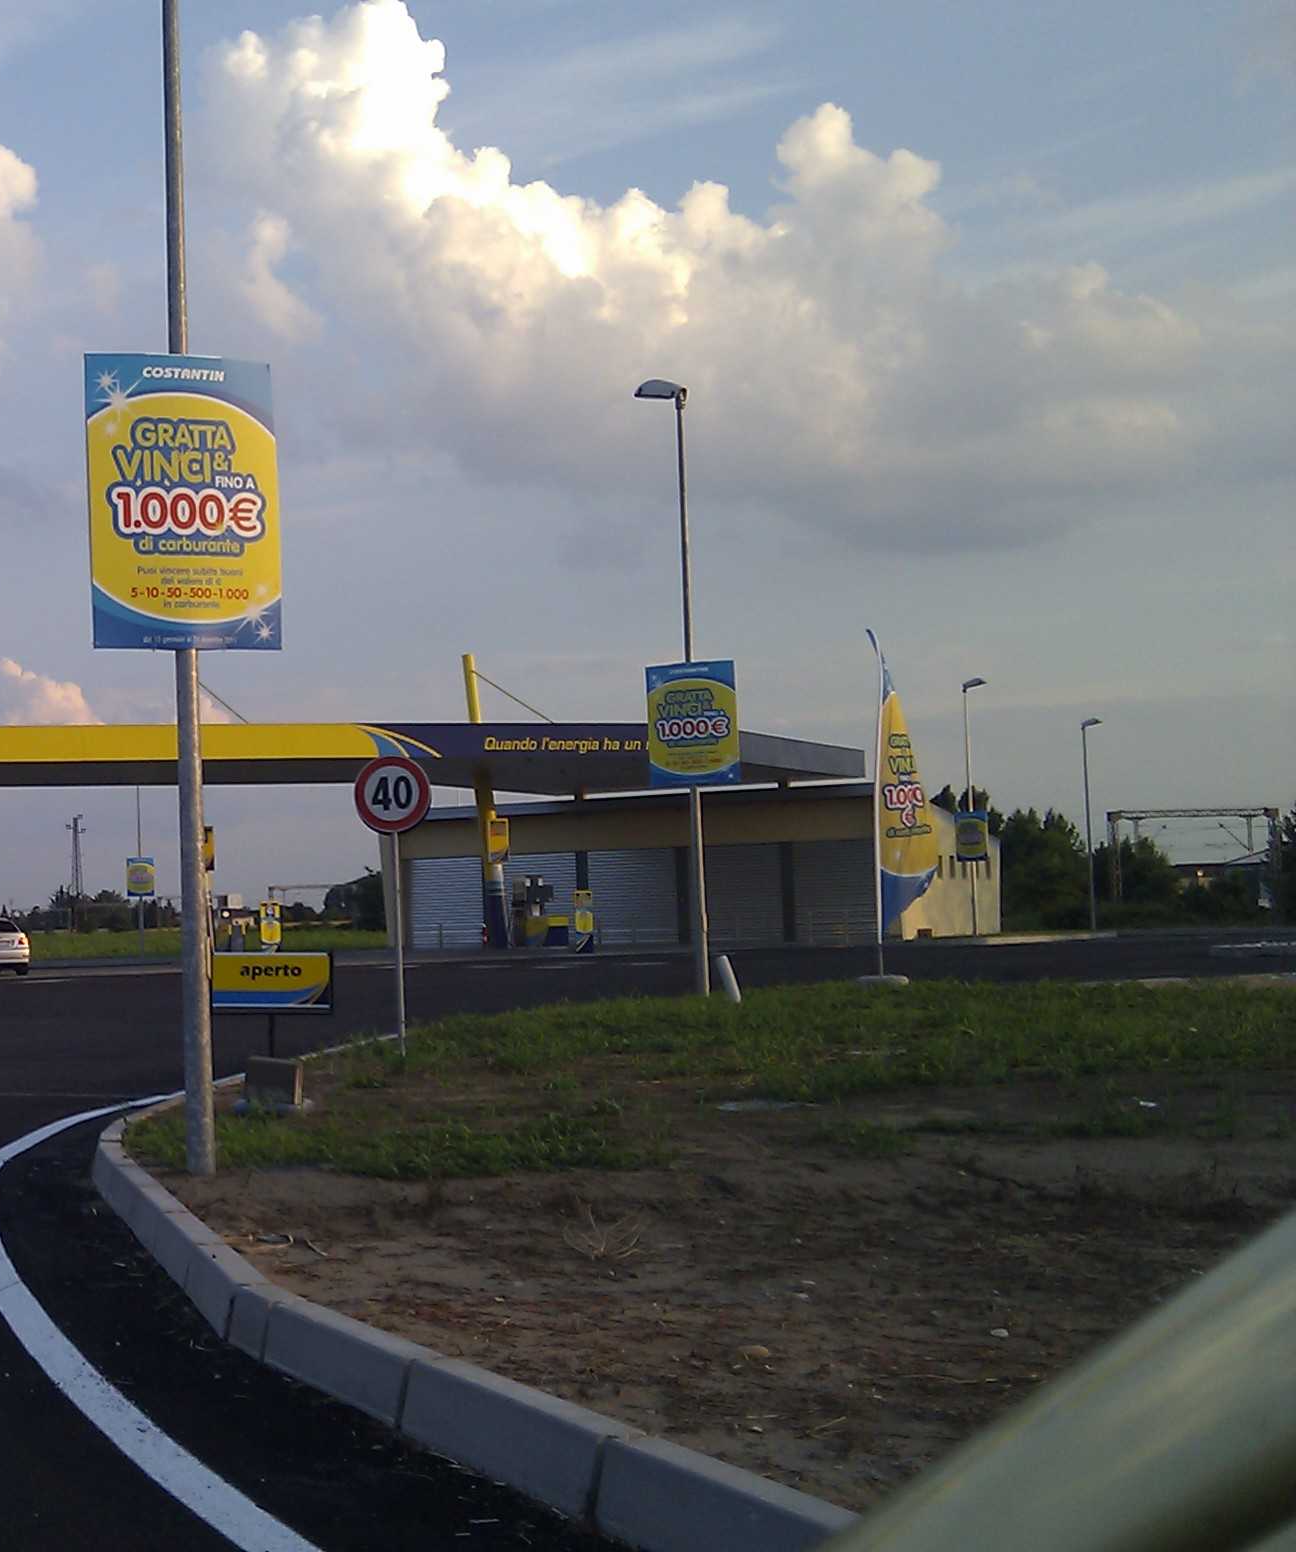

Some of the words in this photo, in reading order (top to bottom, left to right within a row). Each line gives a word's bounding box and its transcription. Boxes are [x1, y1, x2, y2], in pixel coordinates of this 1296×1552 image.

[142, 366, 225, 382] COSTANTIN
[134, 421, 231, 450] GRATTA
[116, 449, 212, 483] VINCI
[213, 450, 229, 471] &
[215, 475, 243, 489] FINO
[245, 477, 255, 489] A
[139, 536, 153, 551] di
[159, 537, 240, 553] carburante
[484, 737, 537, 751] Quando
[542, 737, 600, 754] l'energia
[603, 737, 620, 751] ha
[624, 741, 642, 751] un
[372, 776, 413, 811] 40
[240, 964, 302, 980] aperto
